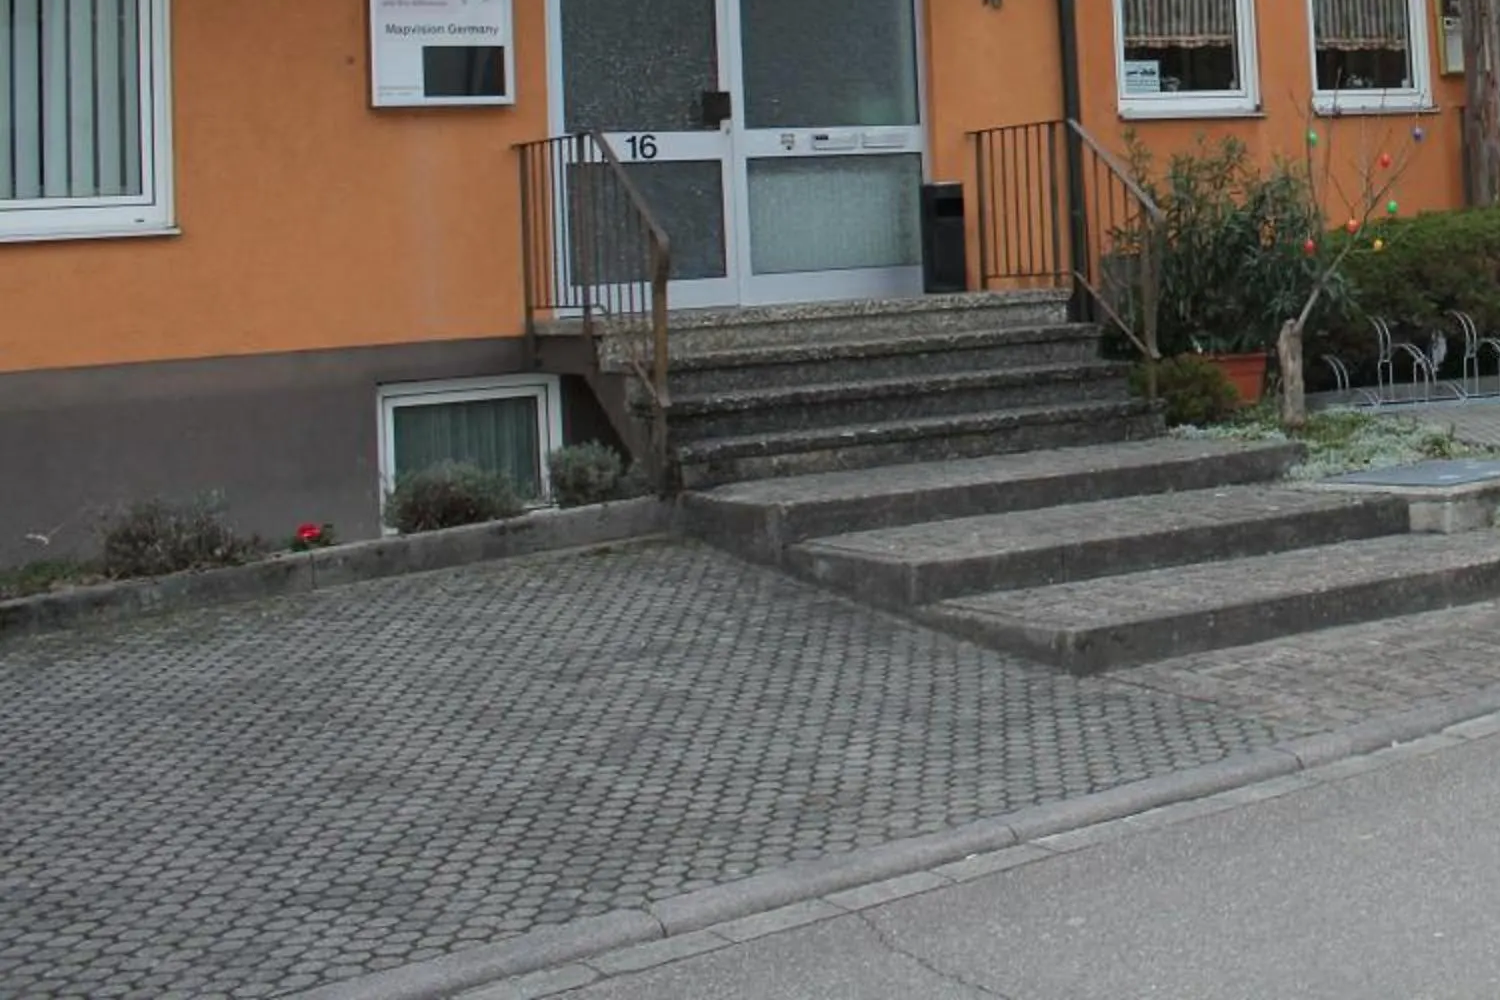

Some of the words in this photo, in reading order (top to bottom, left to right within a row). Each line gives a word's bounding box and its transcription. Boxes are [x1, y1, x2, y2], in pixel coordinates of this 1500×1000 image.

[385, 23, 445, 37] Mapvision
[447, 23, 499, 36] Germany
[625, 134, 657, 159] 16
